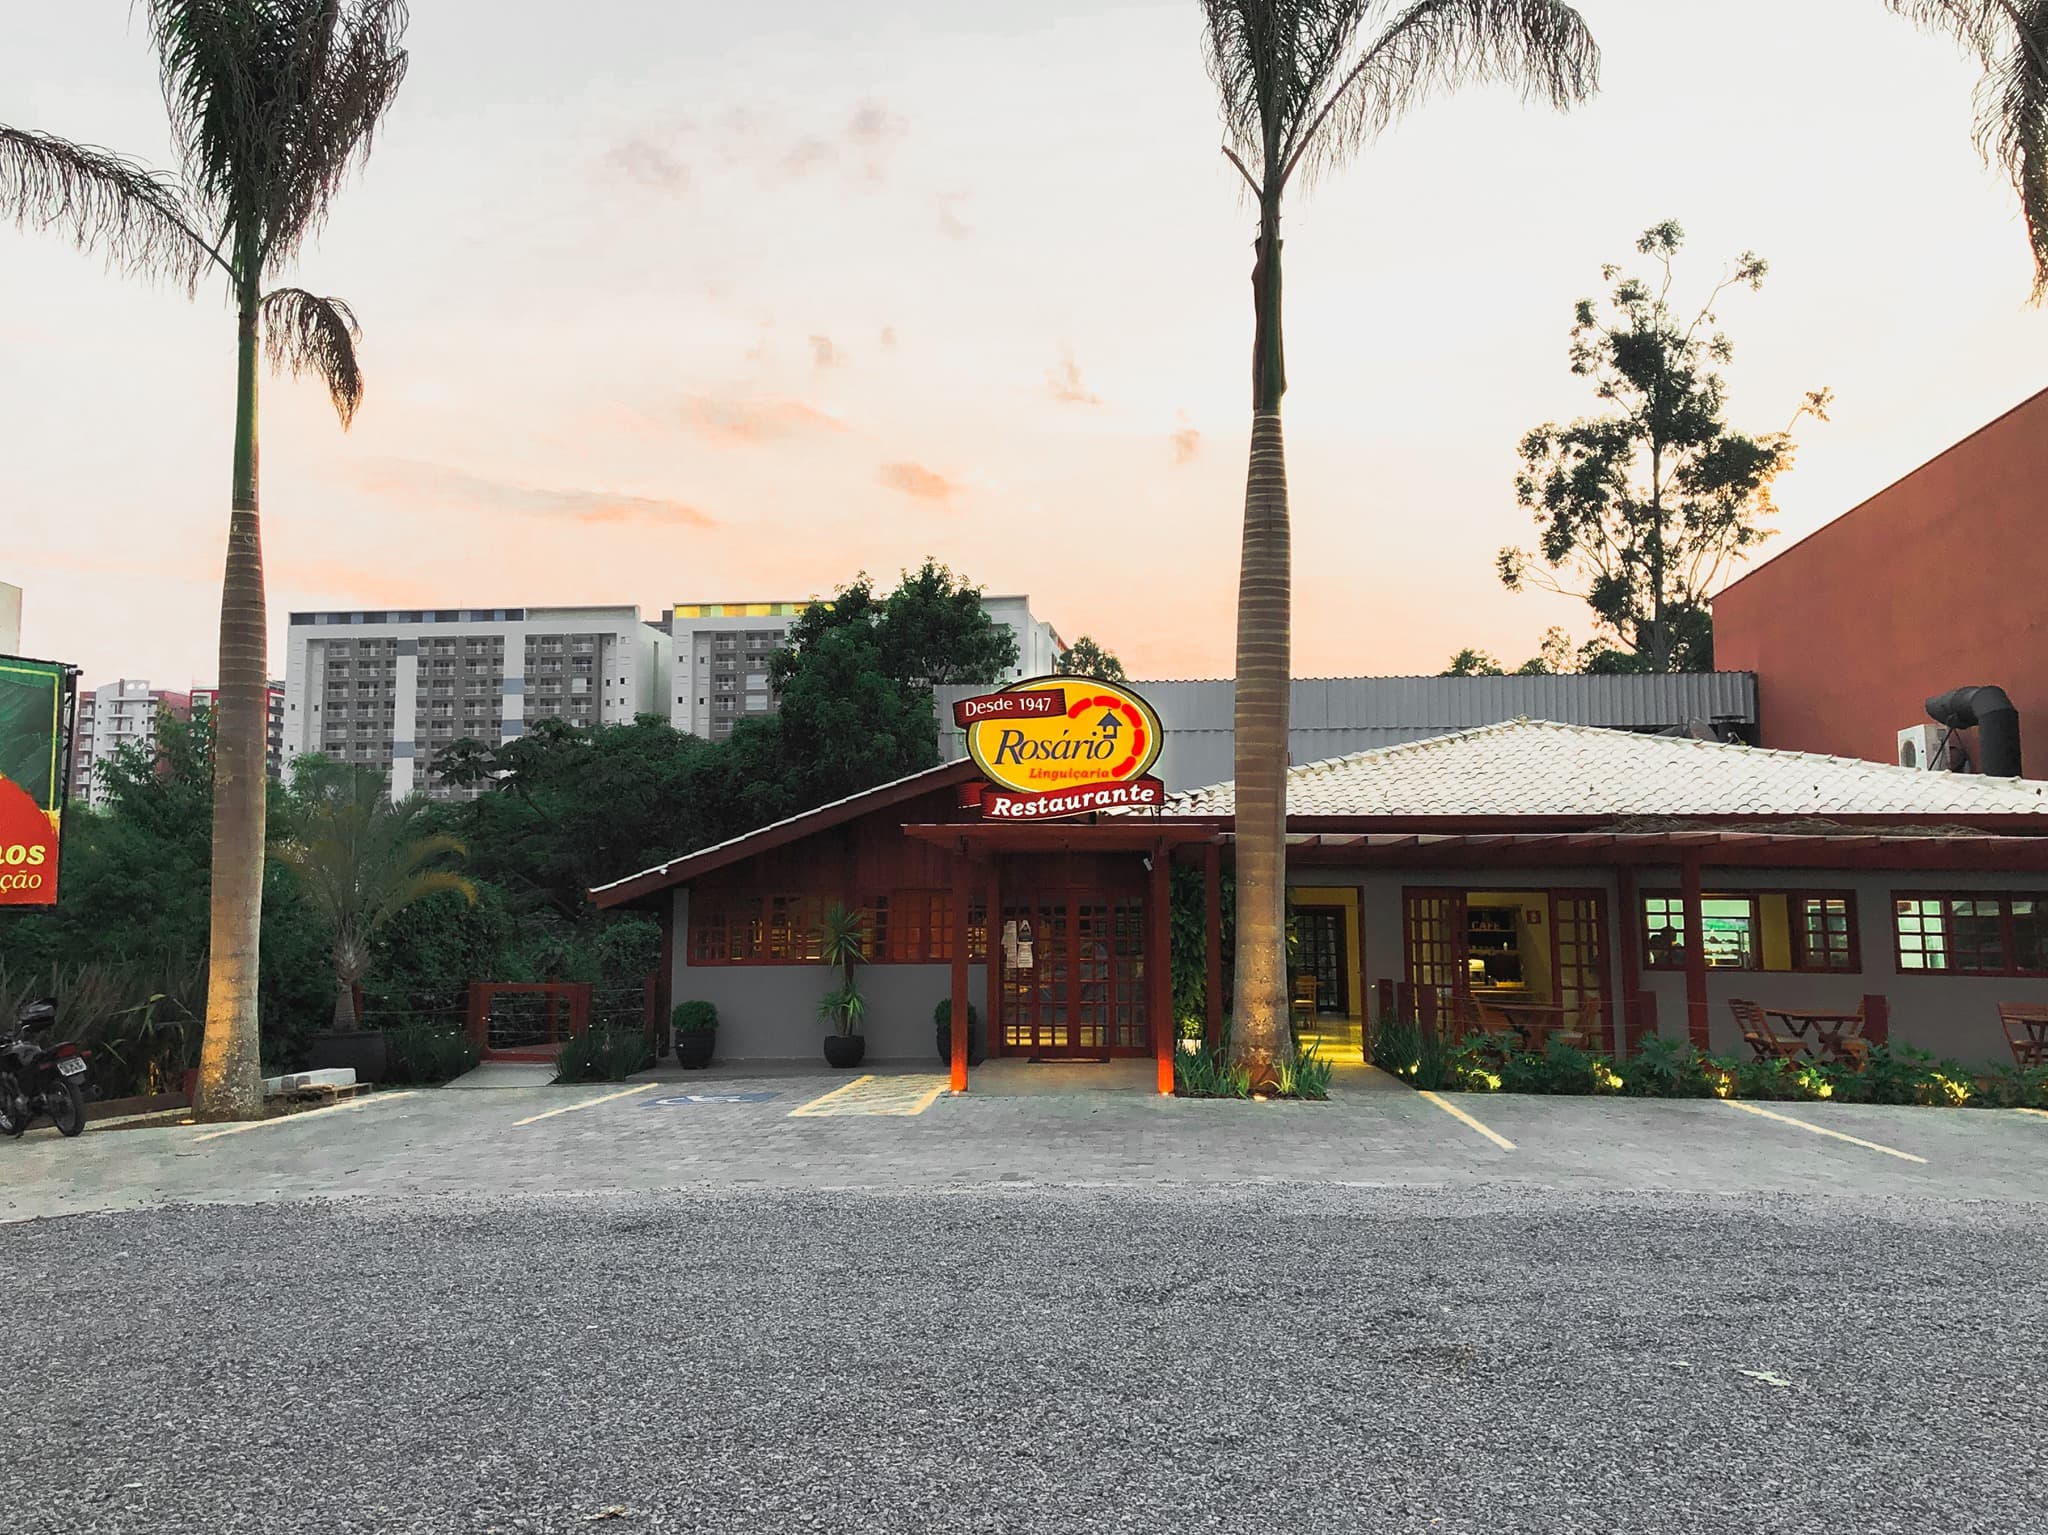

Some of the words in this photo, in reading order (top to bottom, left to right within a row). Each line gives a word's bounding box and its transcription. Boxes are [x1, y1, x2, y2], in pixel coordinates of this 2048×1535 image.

[965, 698, 1013, 717] Desde
[1019, 698, 1052, 712] 1947
[992, 729, 1115, 765] Rosário
[1028, 767, 1110, 782] Linguiçaria
[991, 784, 1155, 817] Restaurante
[0, 844, 46, 866] os
